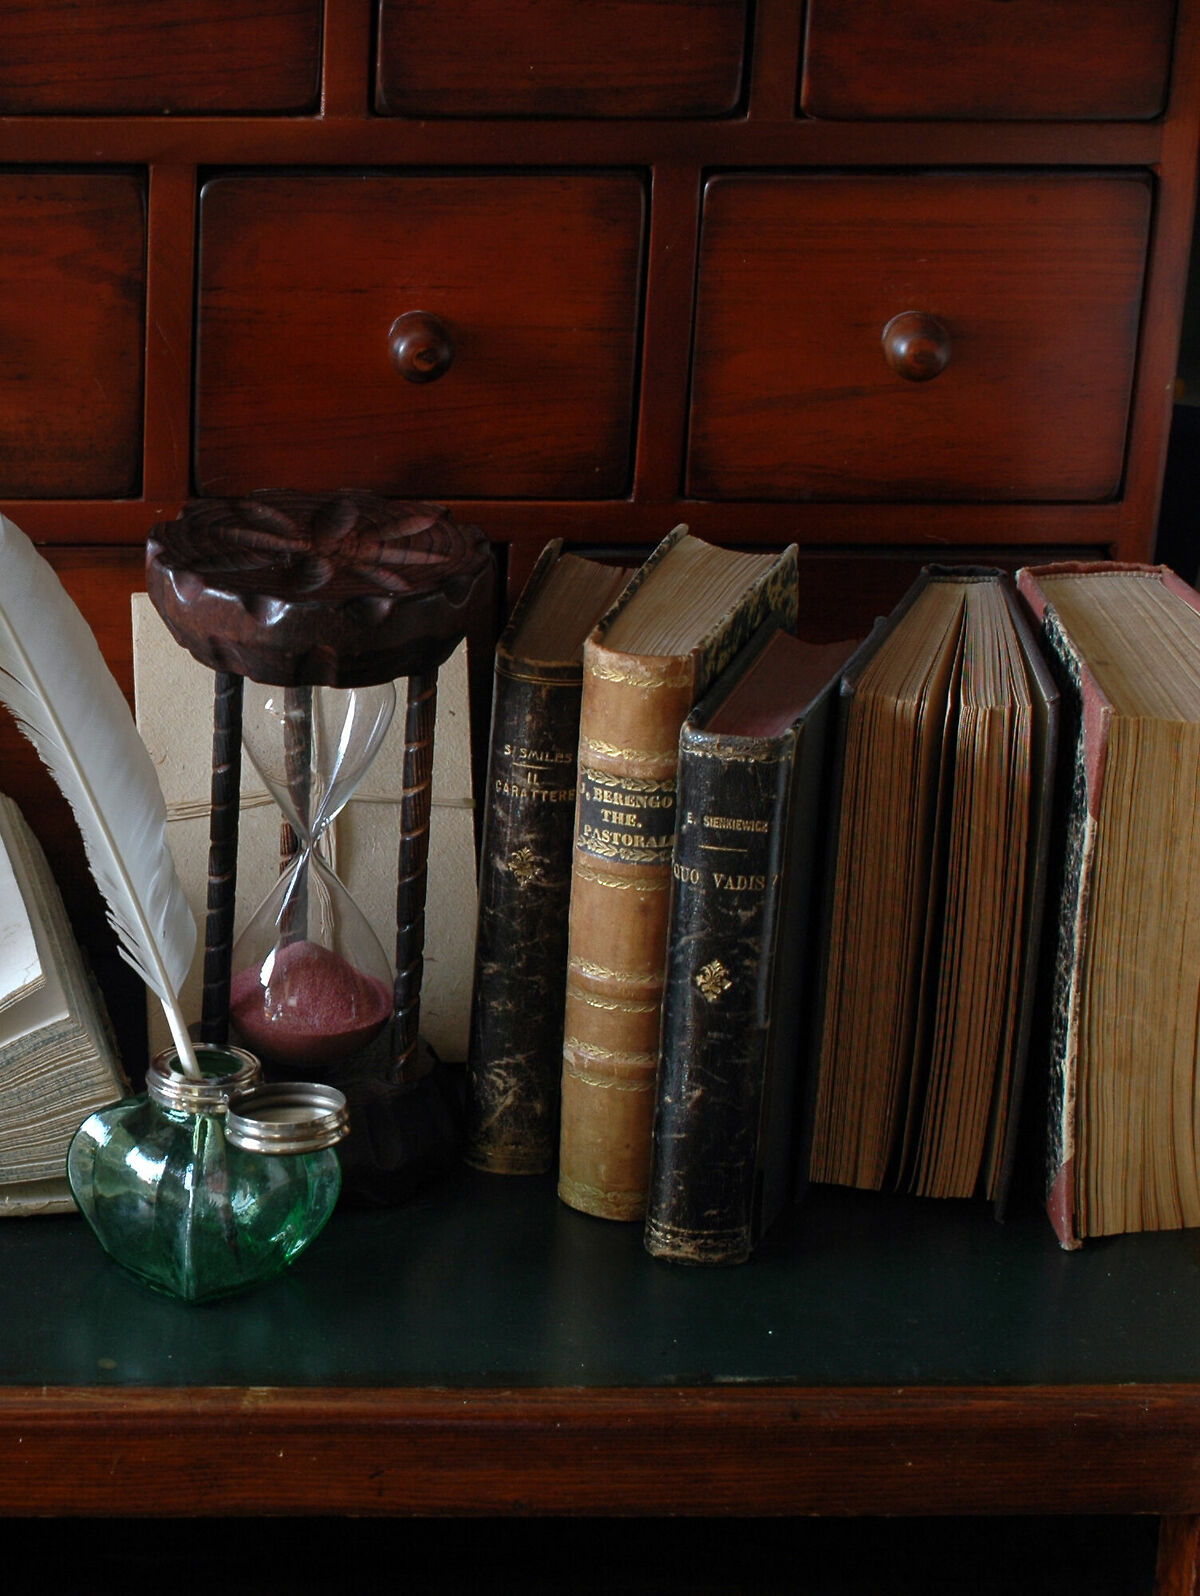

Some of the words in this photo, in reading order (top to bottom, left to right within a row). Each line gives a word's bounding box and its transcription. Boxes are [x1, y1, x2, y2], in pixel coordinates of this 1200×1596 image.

[519, 747, 574, 764] SMILES
[527, 771, 540, 785] IL
[495, 779, 576, 802] CARATTERE
[593, 786, 673, 809] BERENGO
[601, 808, 643, 828] THE.
[673, 863, 700, 885] QUO
[712, 872, 767, 891] VADIS
